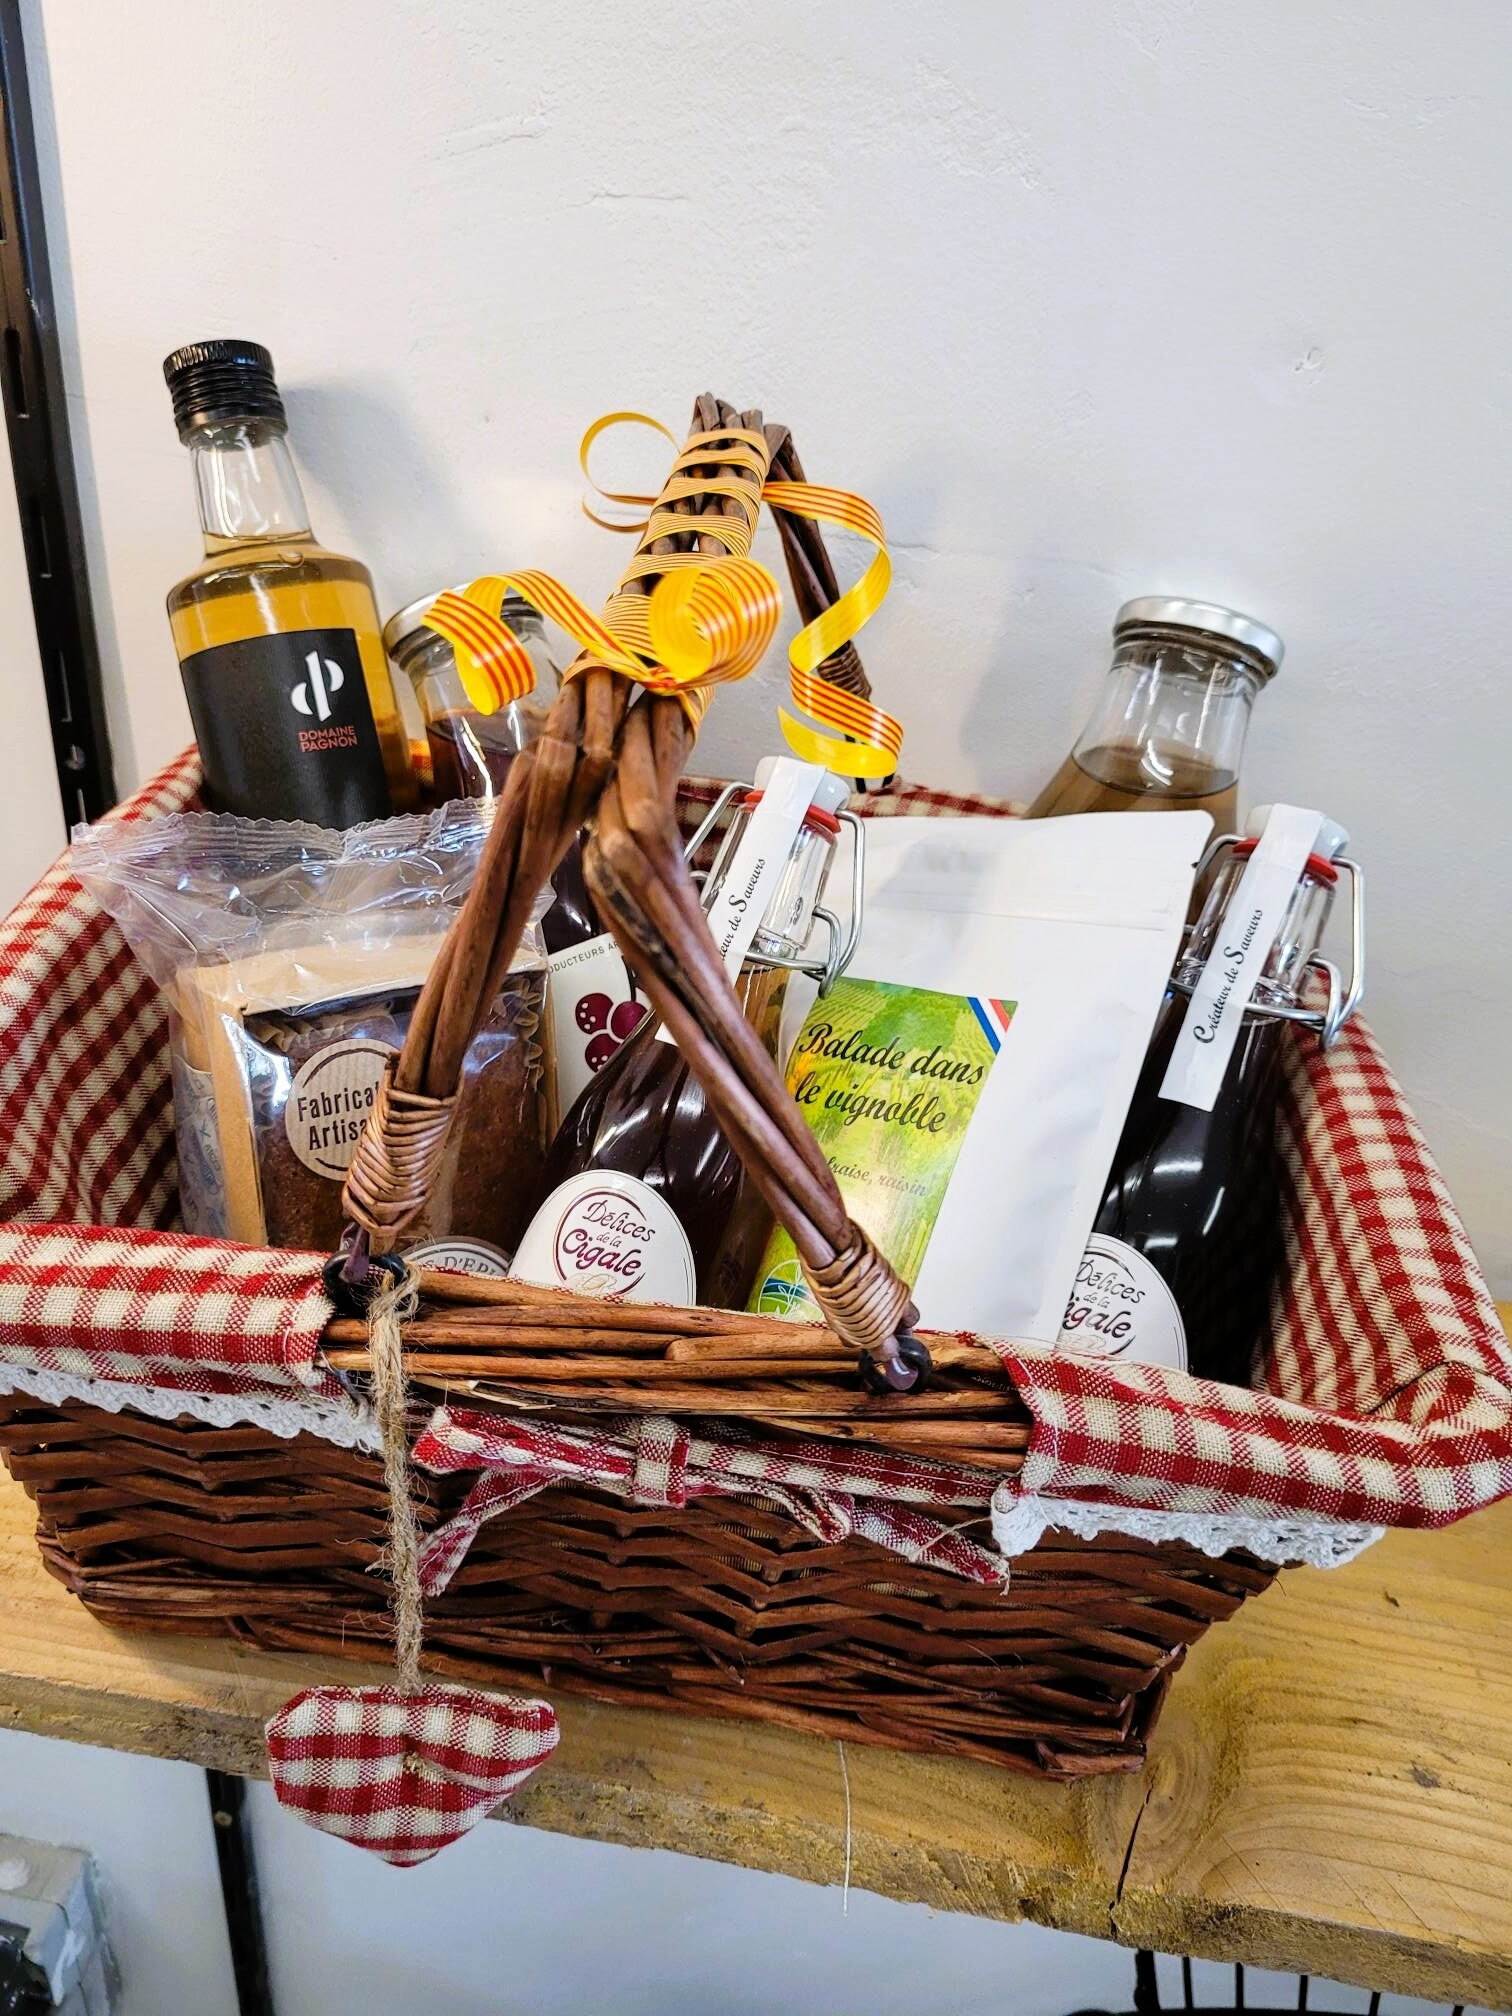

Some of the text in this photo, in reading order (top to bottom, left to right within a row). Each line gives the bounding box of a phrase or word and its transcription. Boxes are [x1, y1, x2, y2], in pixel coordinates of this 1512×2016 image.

[298, 725, 356, 742] DOMAINE
[301, 736, 358, 753] PAGNON
[728, 858, 766, 913] Saveurs
[728, 915, 742, 932] de
[1193, 909, 1263, 1044] Créateur de Saveurs
[799, 1022, 985, 1085] Balade dans
[794, 1071, 946, 1133] le vignoble
[582, 1200, 656, 1242] Délices
[596, 1232, 623, 1248] de la
[562, 1228, 642, 1276] Cigale
[1075, 1259, 1146, 1304] Délices
[1063, 1292, 1132, 1338] igale
